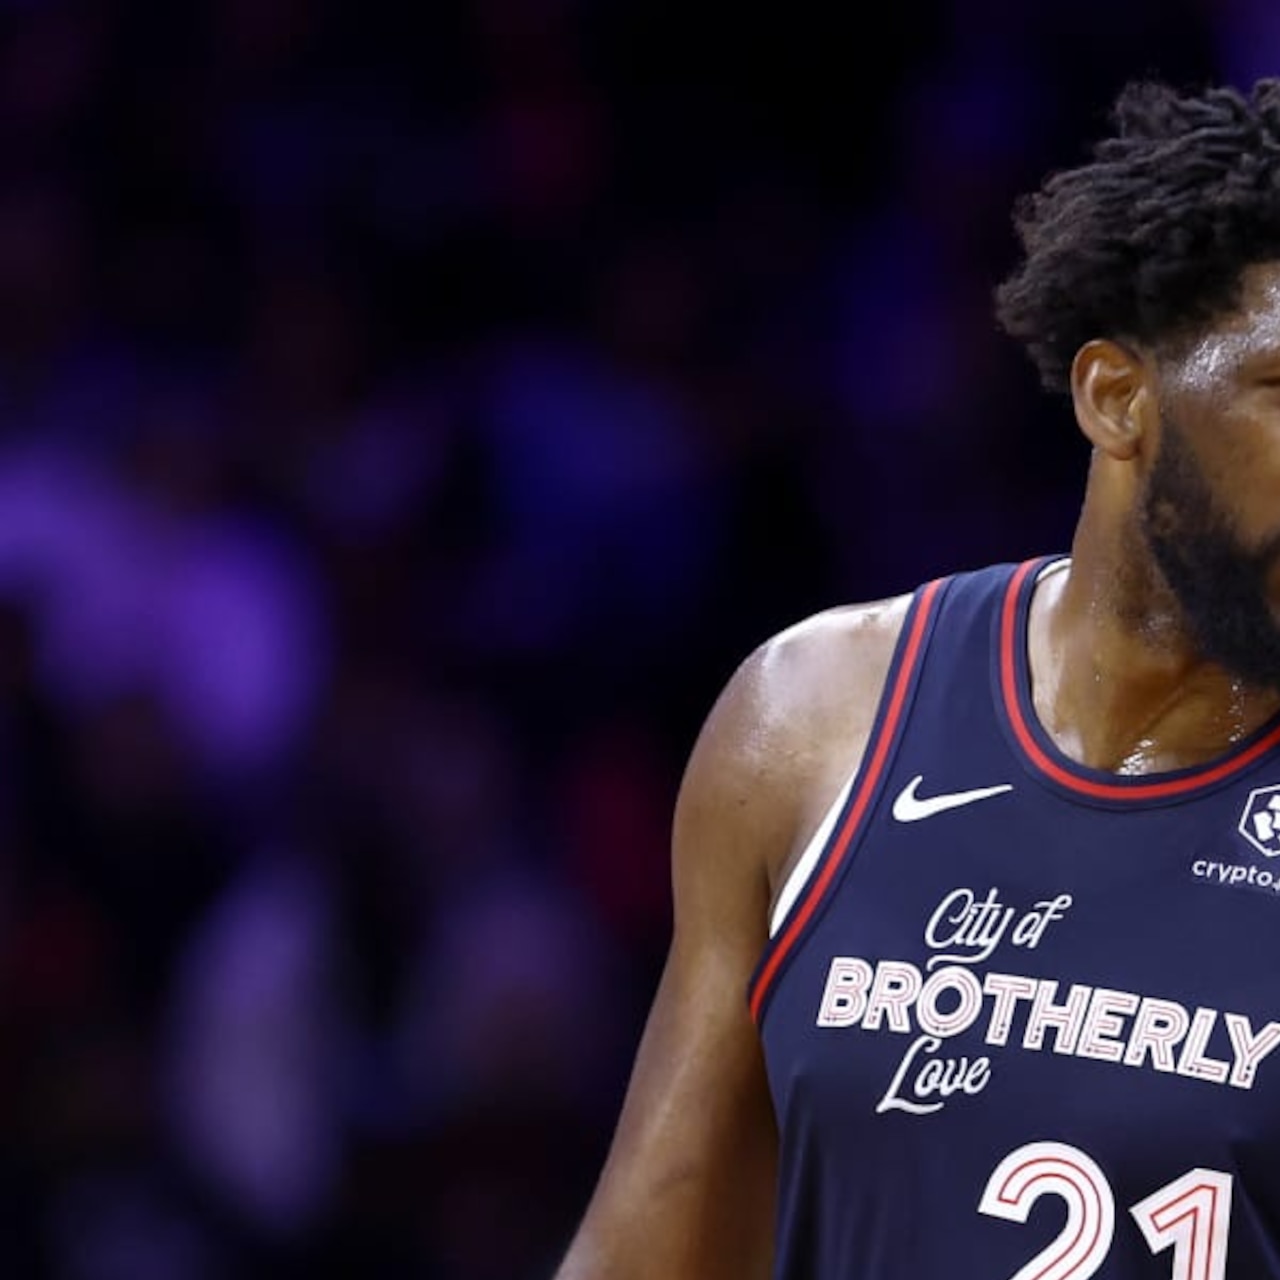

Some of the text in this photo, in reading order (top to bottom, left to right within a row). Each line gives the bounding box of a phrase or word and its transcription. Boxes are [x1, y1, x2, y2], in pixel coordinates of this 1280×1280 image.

[925, 887, 1073, 971] City of
[875, 1034, 991, 1114] Love
